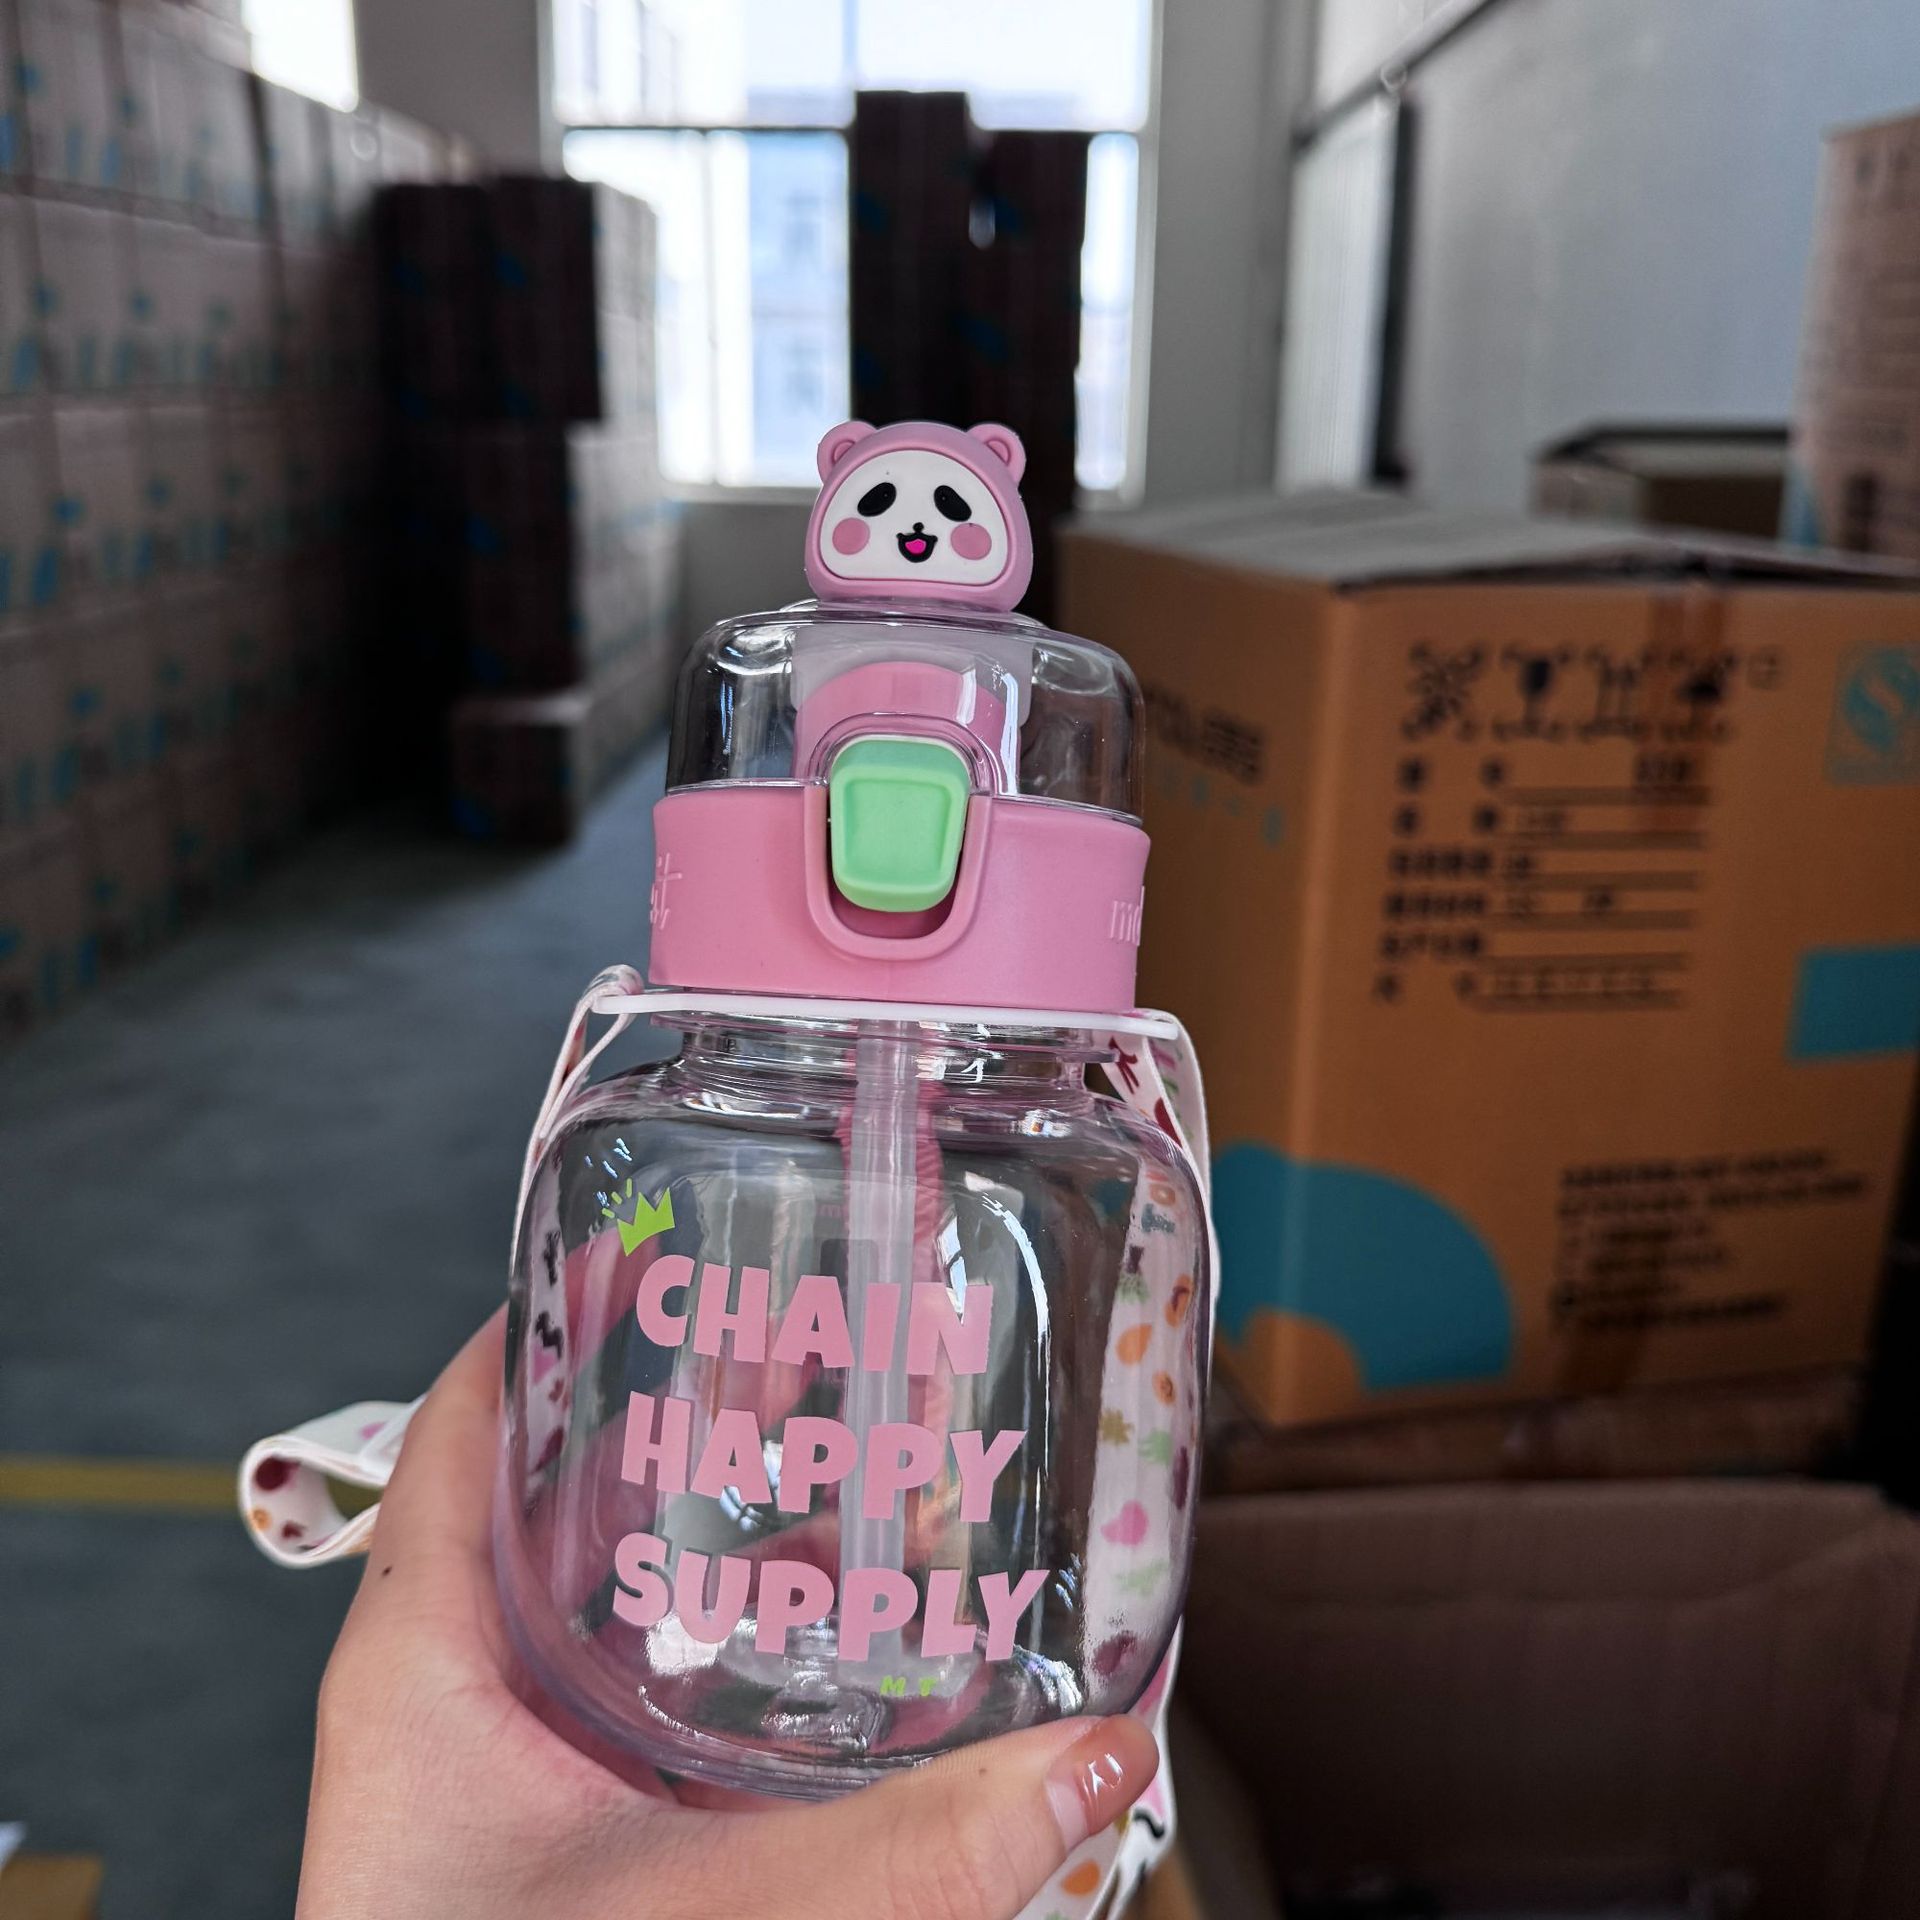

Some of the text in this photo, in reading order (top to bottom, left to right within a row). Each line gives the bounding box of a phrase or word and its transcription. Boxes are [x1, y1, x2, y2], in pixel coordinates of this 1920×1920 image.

[636, 1255, 994, 1376] CHAIN
[621, 1391, 1027, 1523] HAPPY
[613, 1532, 1050, 1662] SUPPLY
